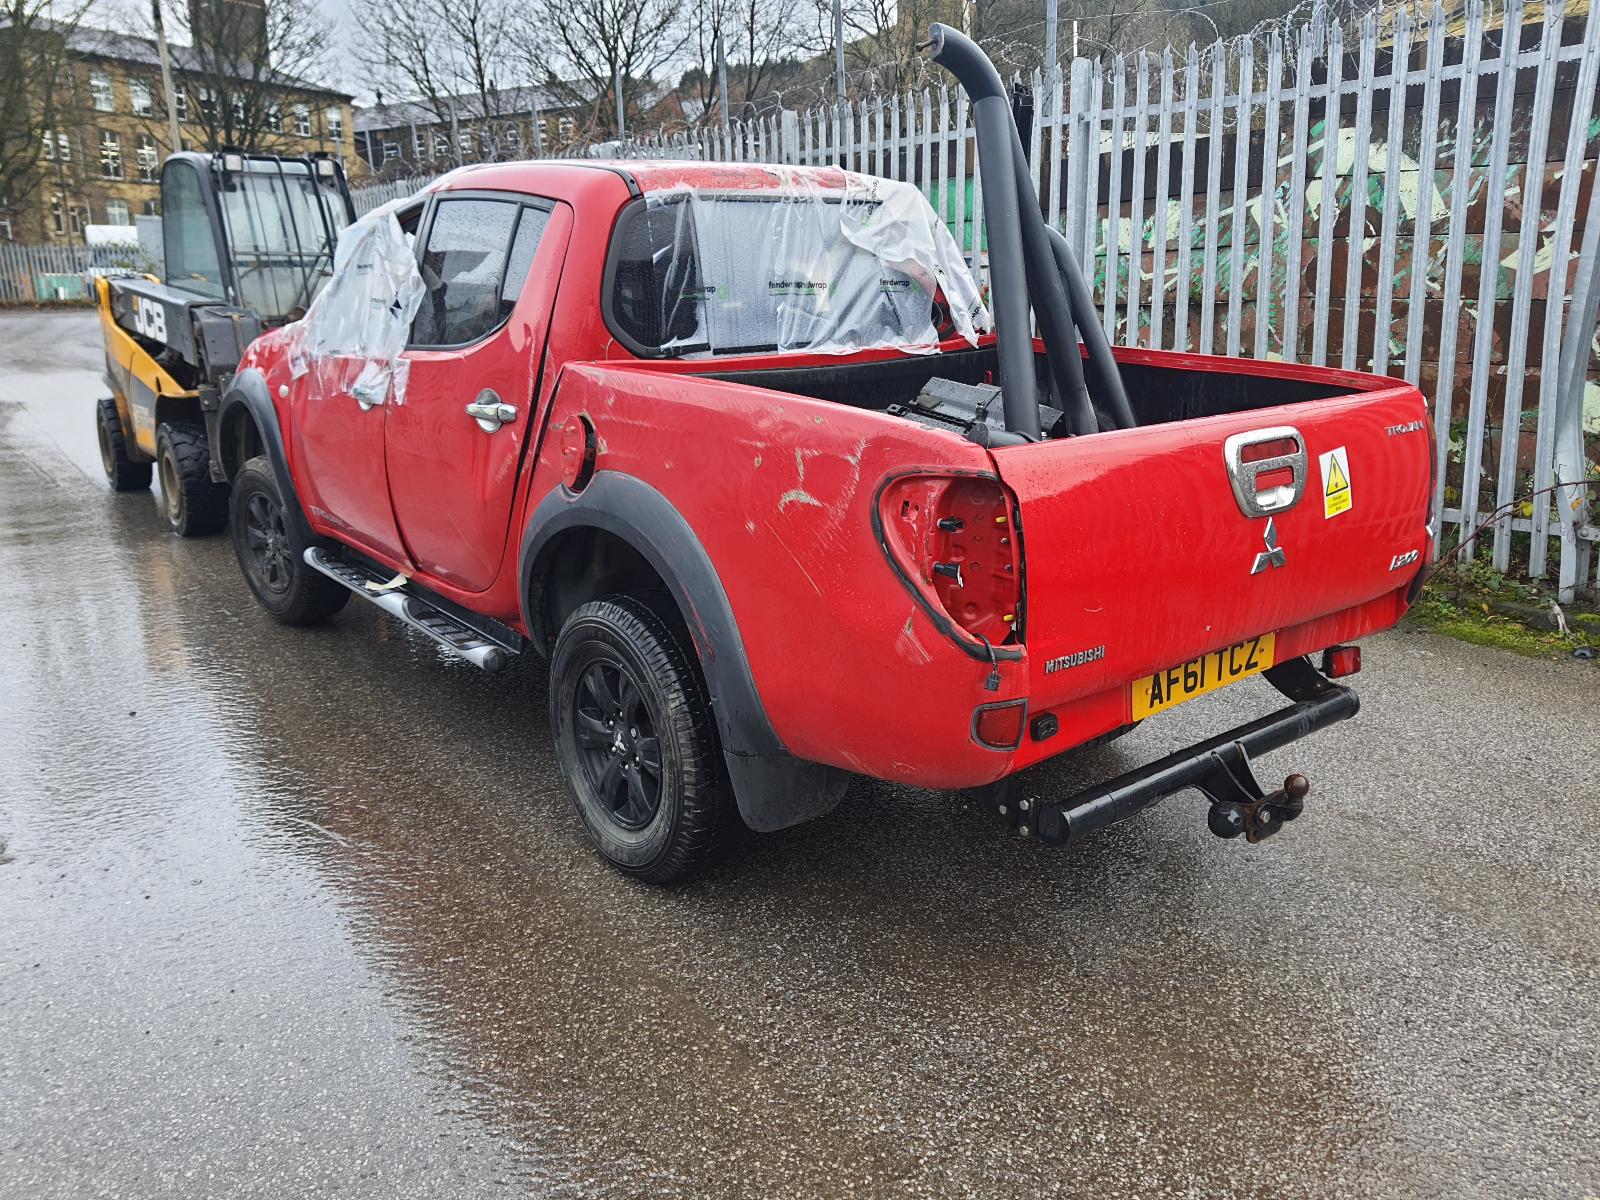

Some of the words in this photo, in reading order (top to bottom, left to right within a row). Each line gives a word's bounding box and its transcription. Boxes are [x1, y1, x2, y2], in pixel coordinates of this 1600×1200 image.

[134, 294, 167, 343] JCB
[1384, 420, 1424, 436] TROJAN
[1389, 549, 1418, 571] L200
[1045, 645, 1105, 674] MITSUBISHI
[1149, 656, 1206, 709] AF61
[1214, 635, 1261, 682] TCZ
